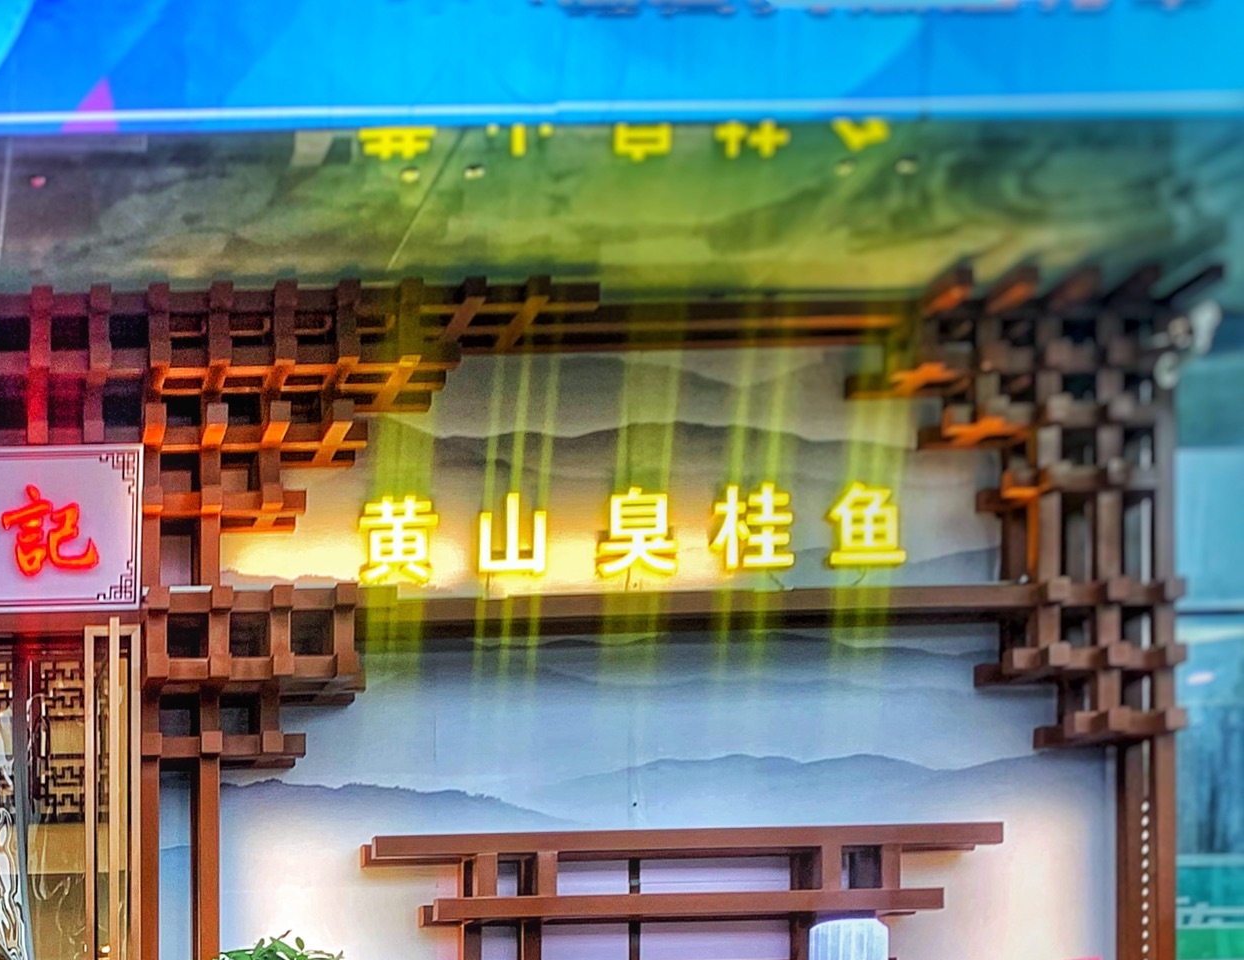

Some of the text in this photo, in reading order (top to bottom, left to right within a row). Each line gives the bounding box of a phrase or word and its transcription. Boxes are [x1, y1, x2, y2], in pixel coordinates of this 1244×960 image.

[357, 482, 907, 586] 黄山臭桂鱼
